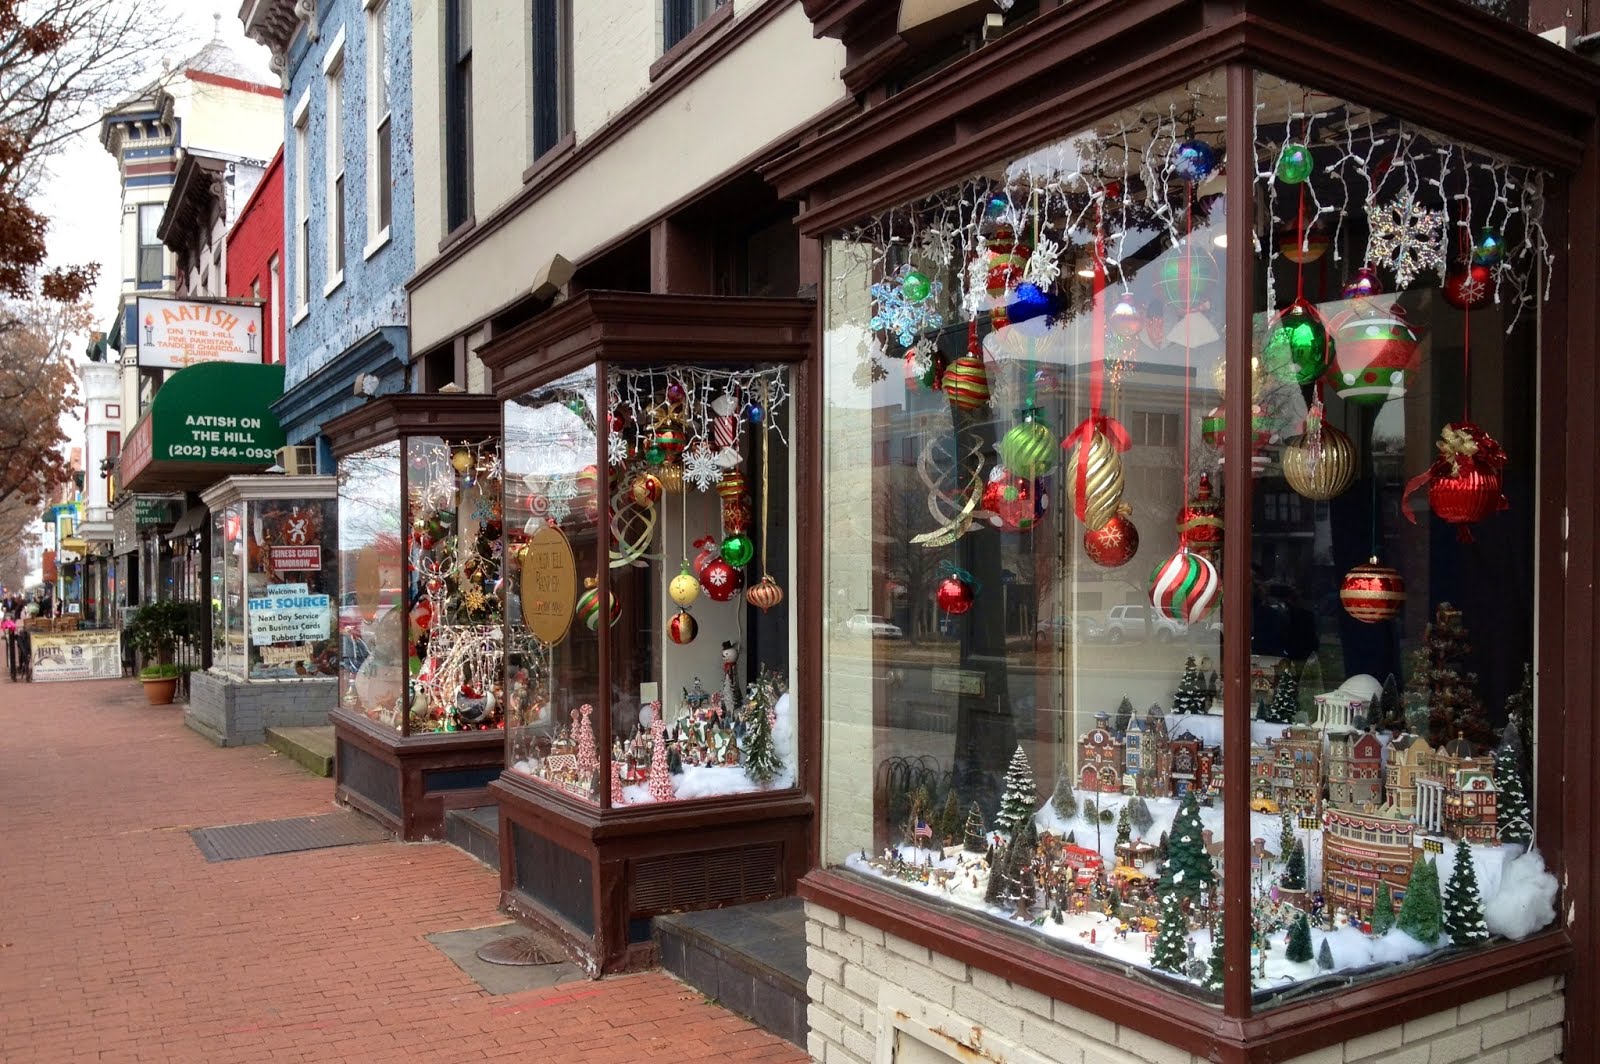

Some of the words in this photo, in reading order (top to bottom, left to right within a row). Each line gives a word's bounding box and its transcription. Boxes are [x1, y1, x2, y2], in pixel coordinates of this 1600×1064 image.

[162, 305, 239, 332] AATISH
[188, 329, 208, 337] THE
[198, 344, 244, 352] CHARCOAL
[186, 415, 236, 427] AATISH
[240, 418, 261, 428] ON
[192, 430, 220, 441] THE
[224, 432, 255, 443] HILL
[168, 444, 206, 458] (202)
[271, 550, 296, 558] USINESS
[274, 559, 310, 568] TOMORROW
[249, 599, 272, 610] THE
[276, 597, 327, 608] SOURCE
[278, 614, 292, 622] Day
